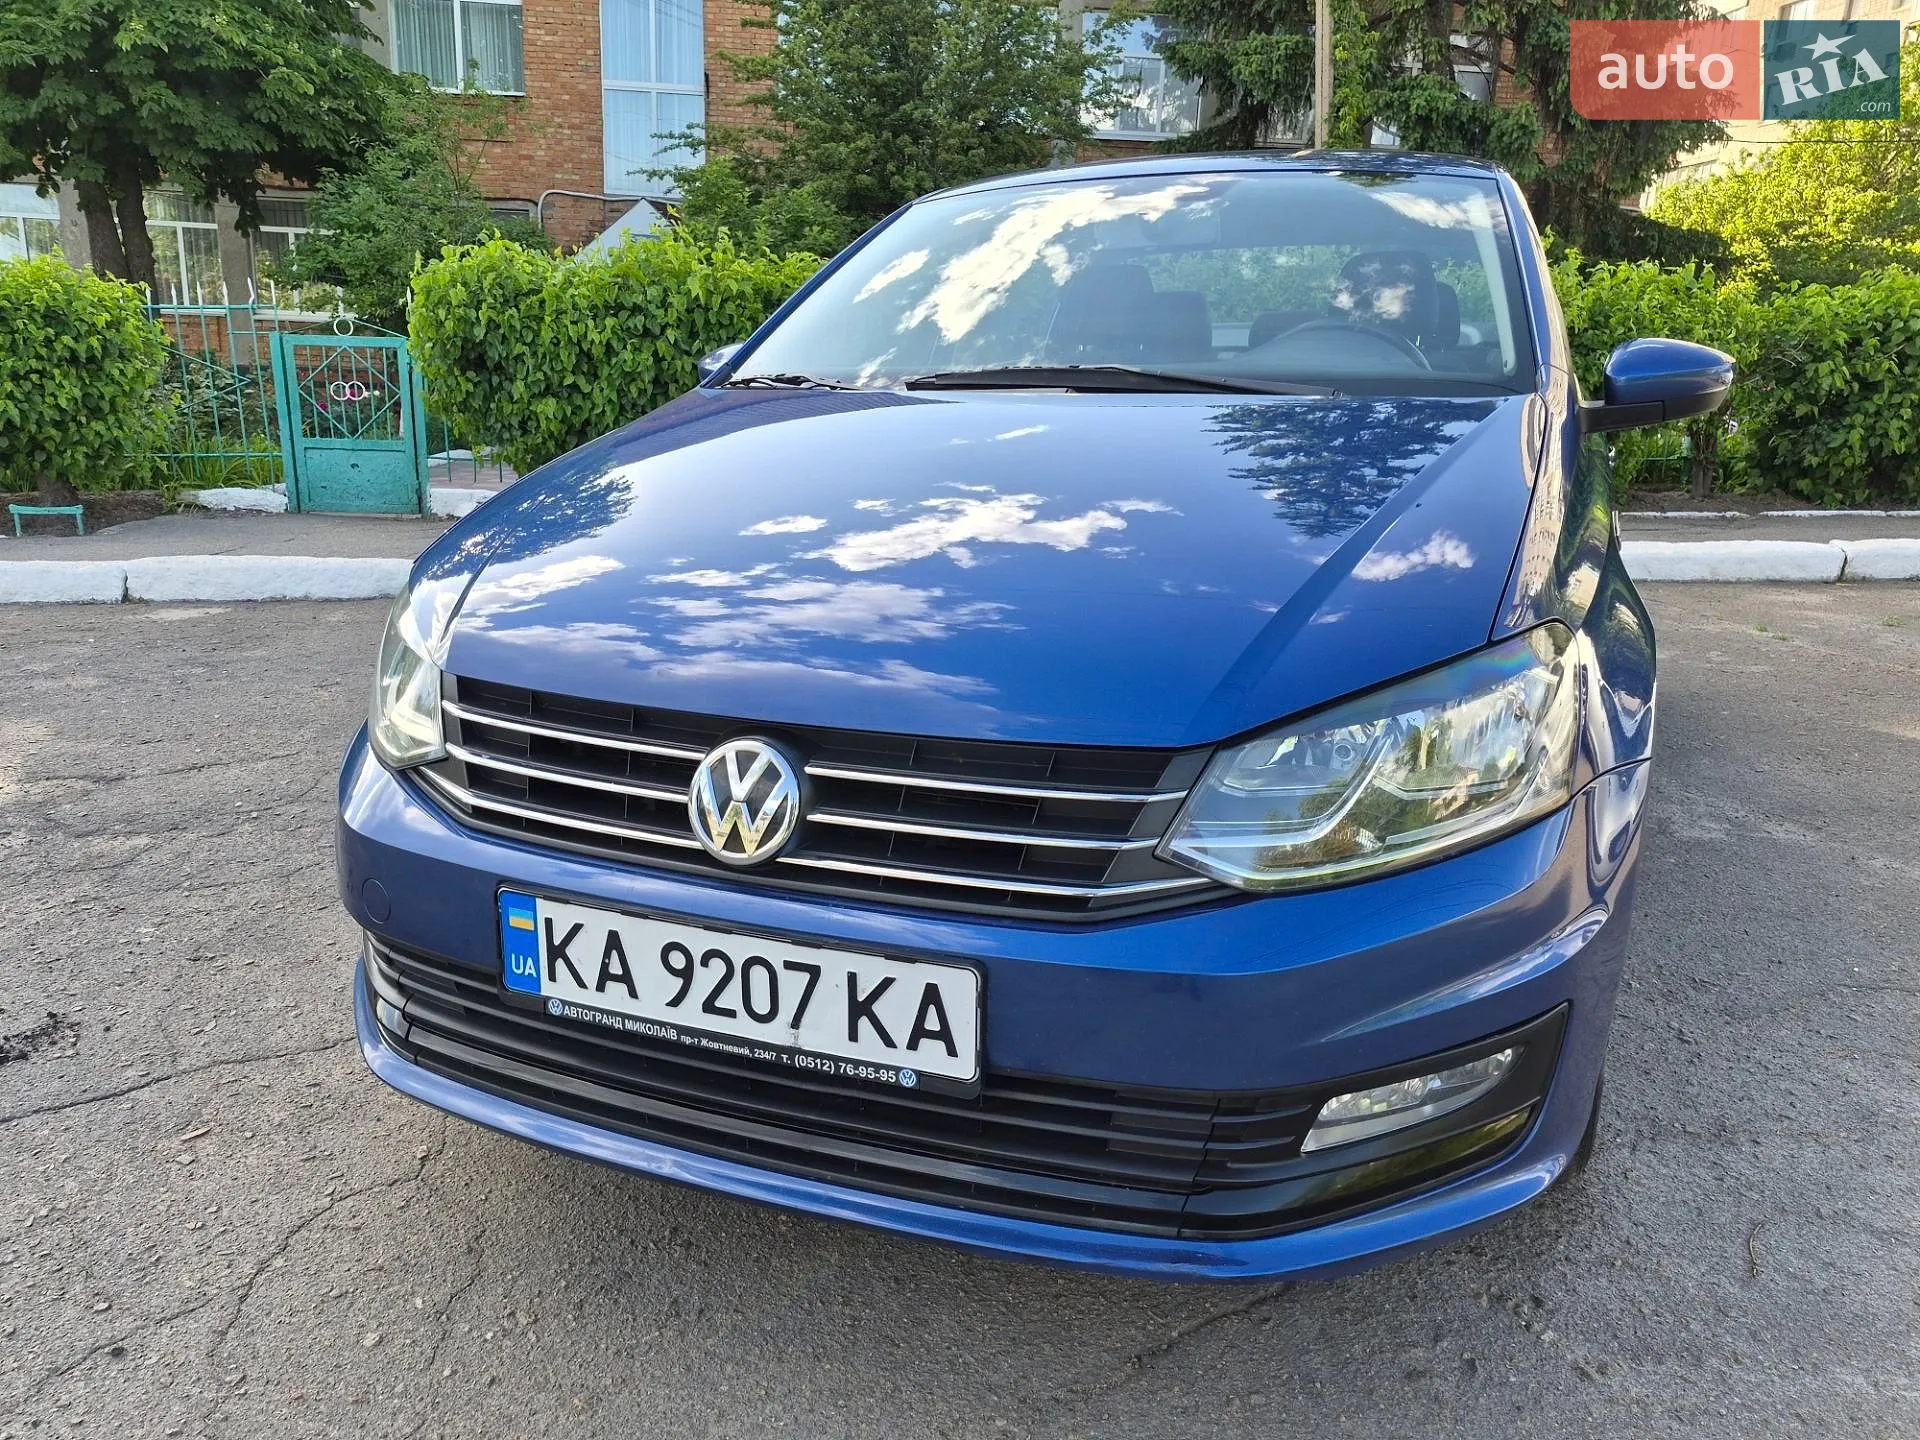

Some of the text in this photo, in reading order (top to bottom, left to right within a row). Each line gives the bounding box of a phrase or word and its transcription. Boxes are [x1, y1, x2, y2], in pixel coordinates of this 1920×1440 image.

[688, 739, 799, 865] VW
[511, 953, 537, 978] UA
[544, 917, 959, 1058] KA 9207 KA
[563, 1005, 897, 1083] АВТОГРАНД МИКОЛАЇВ пр-т Жовтневий, 234/7 т. (0512) 76-95-95
